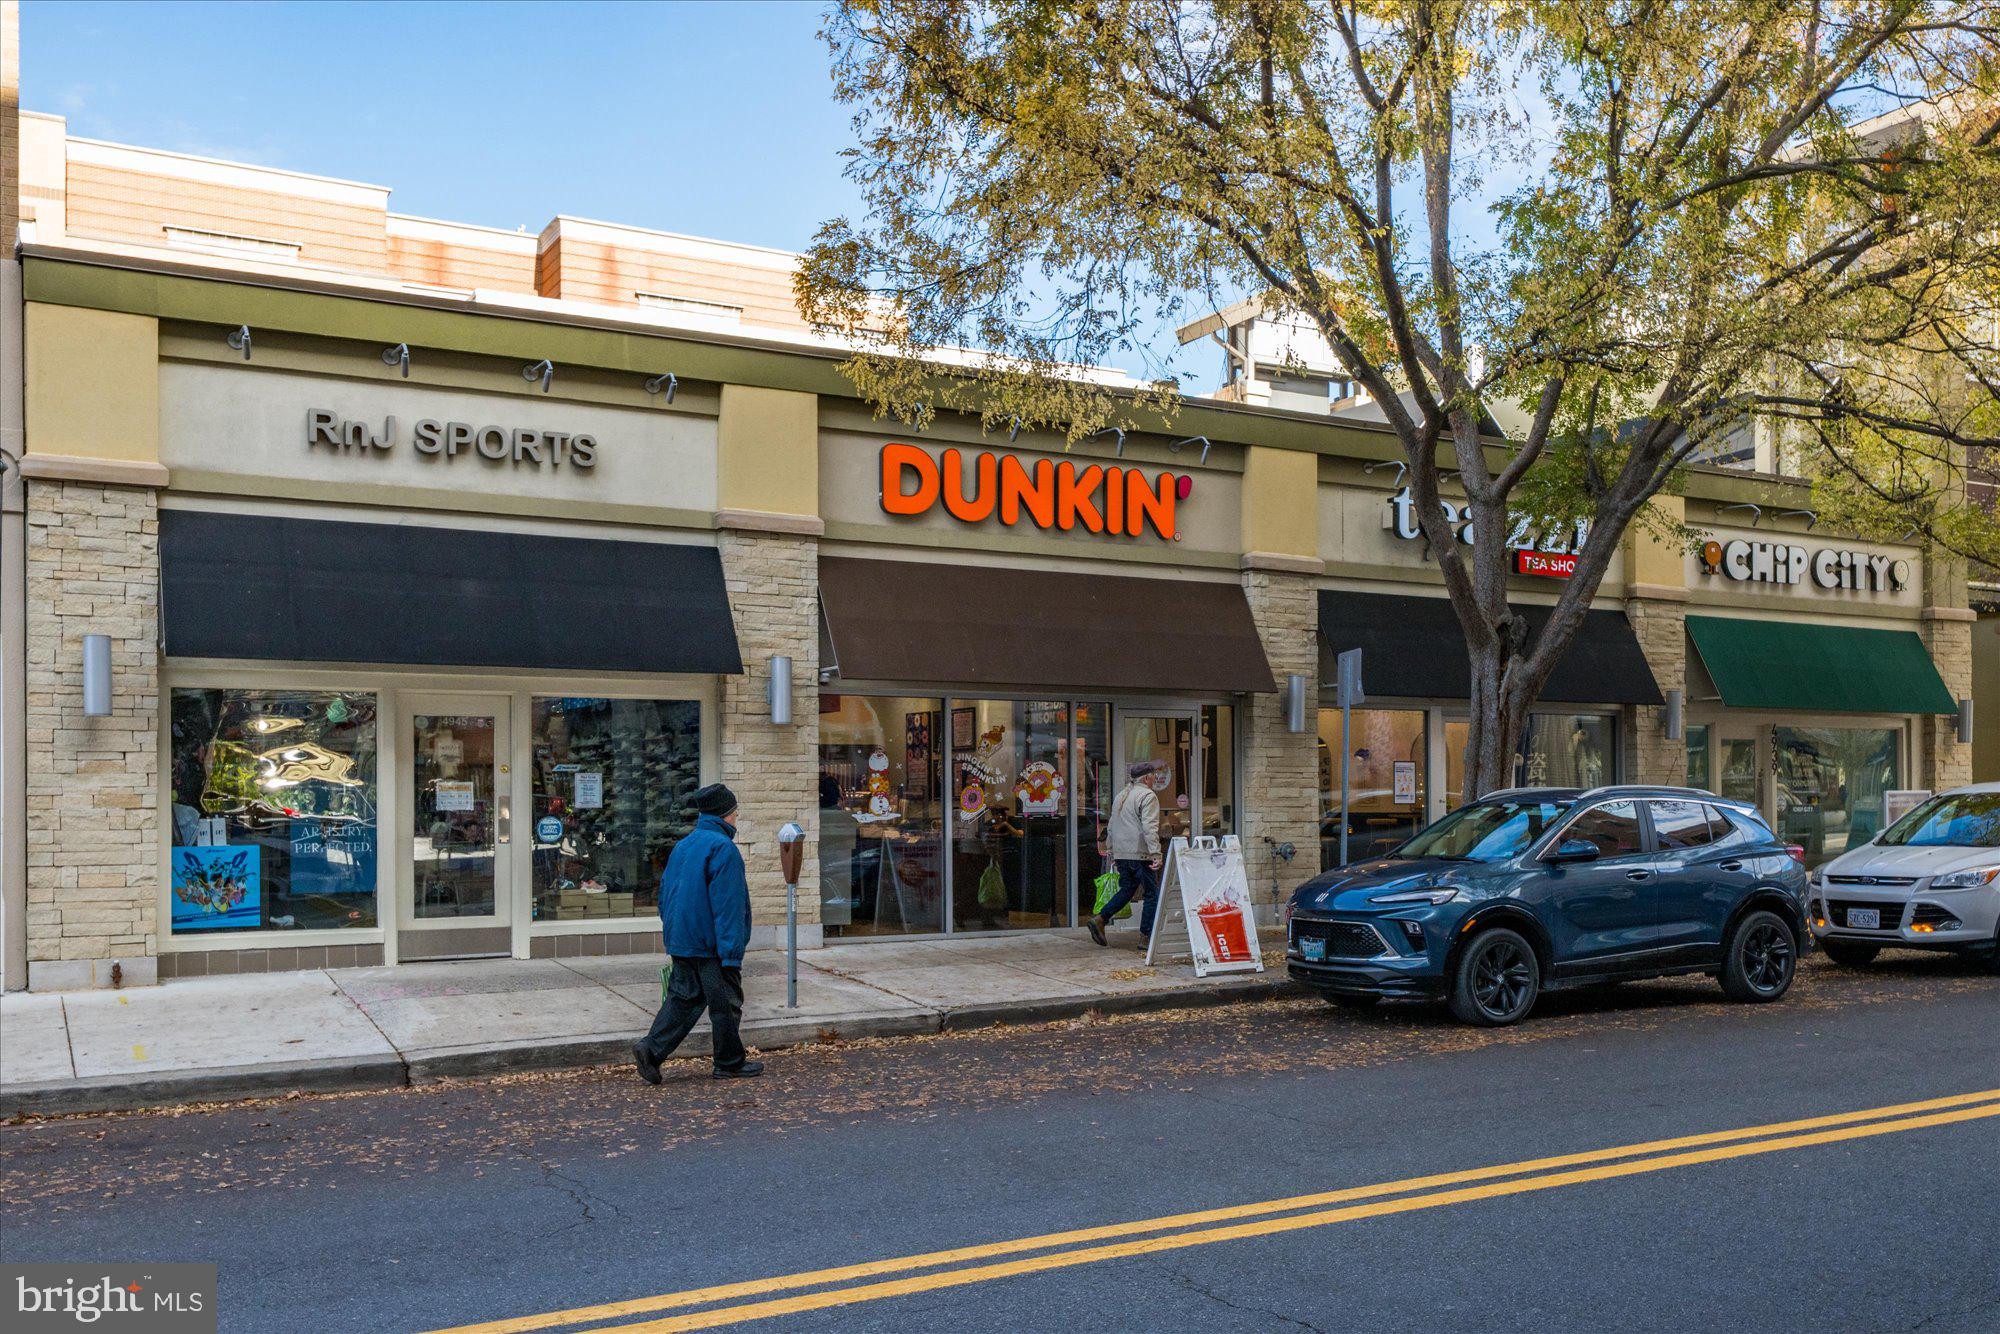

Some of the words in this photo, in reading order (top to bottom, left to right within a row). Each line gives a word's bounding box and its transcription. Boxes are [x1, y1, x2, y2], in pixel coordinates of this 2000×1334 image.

[306, 407, 396, 450] RnJ
[413, 418, 598, 468] SPORTS
[880, 442, 1192, 541] DUNKIN'
[1524, 556, 1548, 571] TEA
[1771, 723, 1779, 775] 4939
[1216, 933, 1231, 960] ICED
